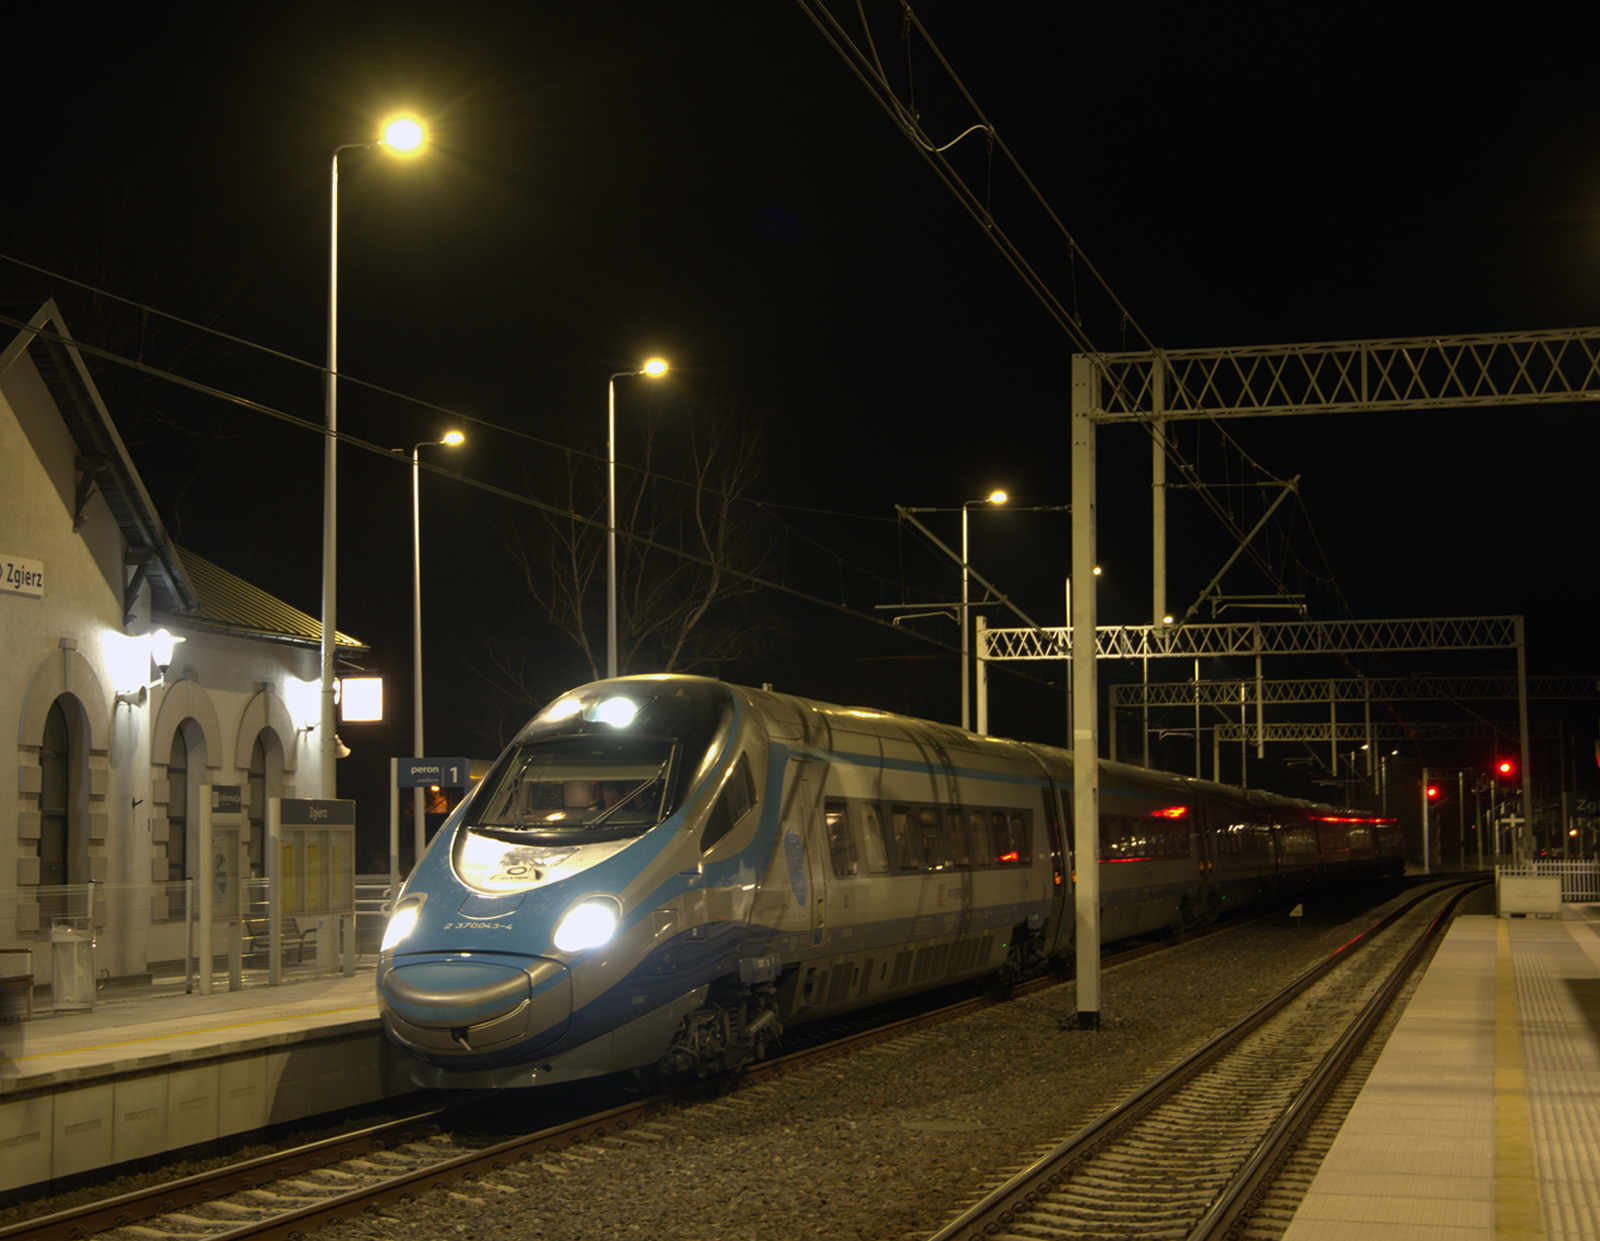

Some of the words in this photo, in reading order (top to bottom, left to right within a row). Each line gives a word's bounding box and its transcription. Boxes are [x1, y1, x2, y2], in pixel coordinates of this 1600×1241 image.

[7, 563, 42, 589] Zgierz
[411, 766, 439, 775] peron
[450, 766, 458, 784] 1
[309, 806, 328, 821] Zgierz
[443, 922, 453, 930] 2
